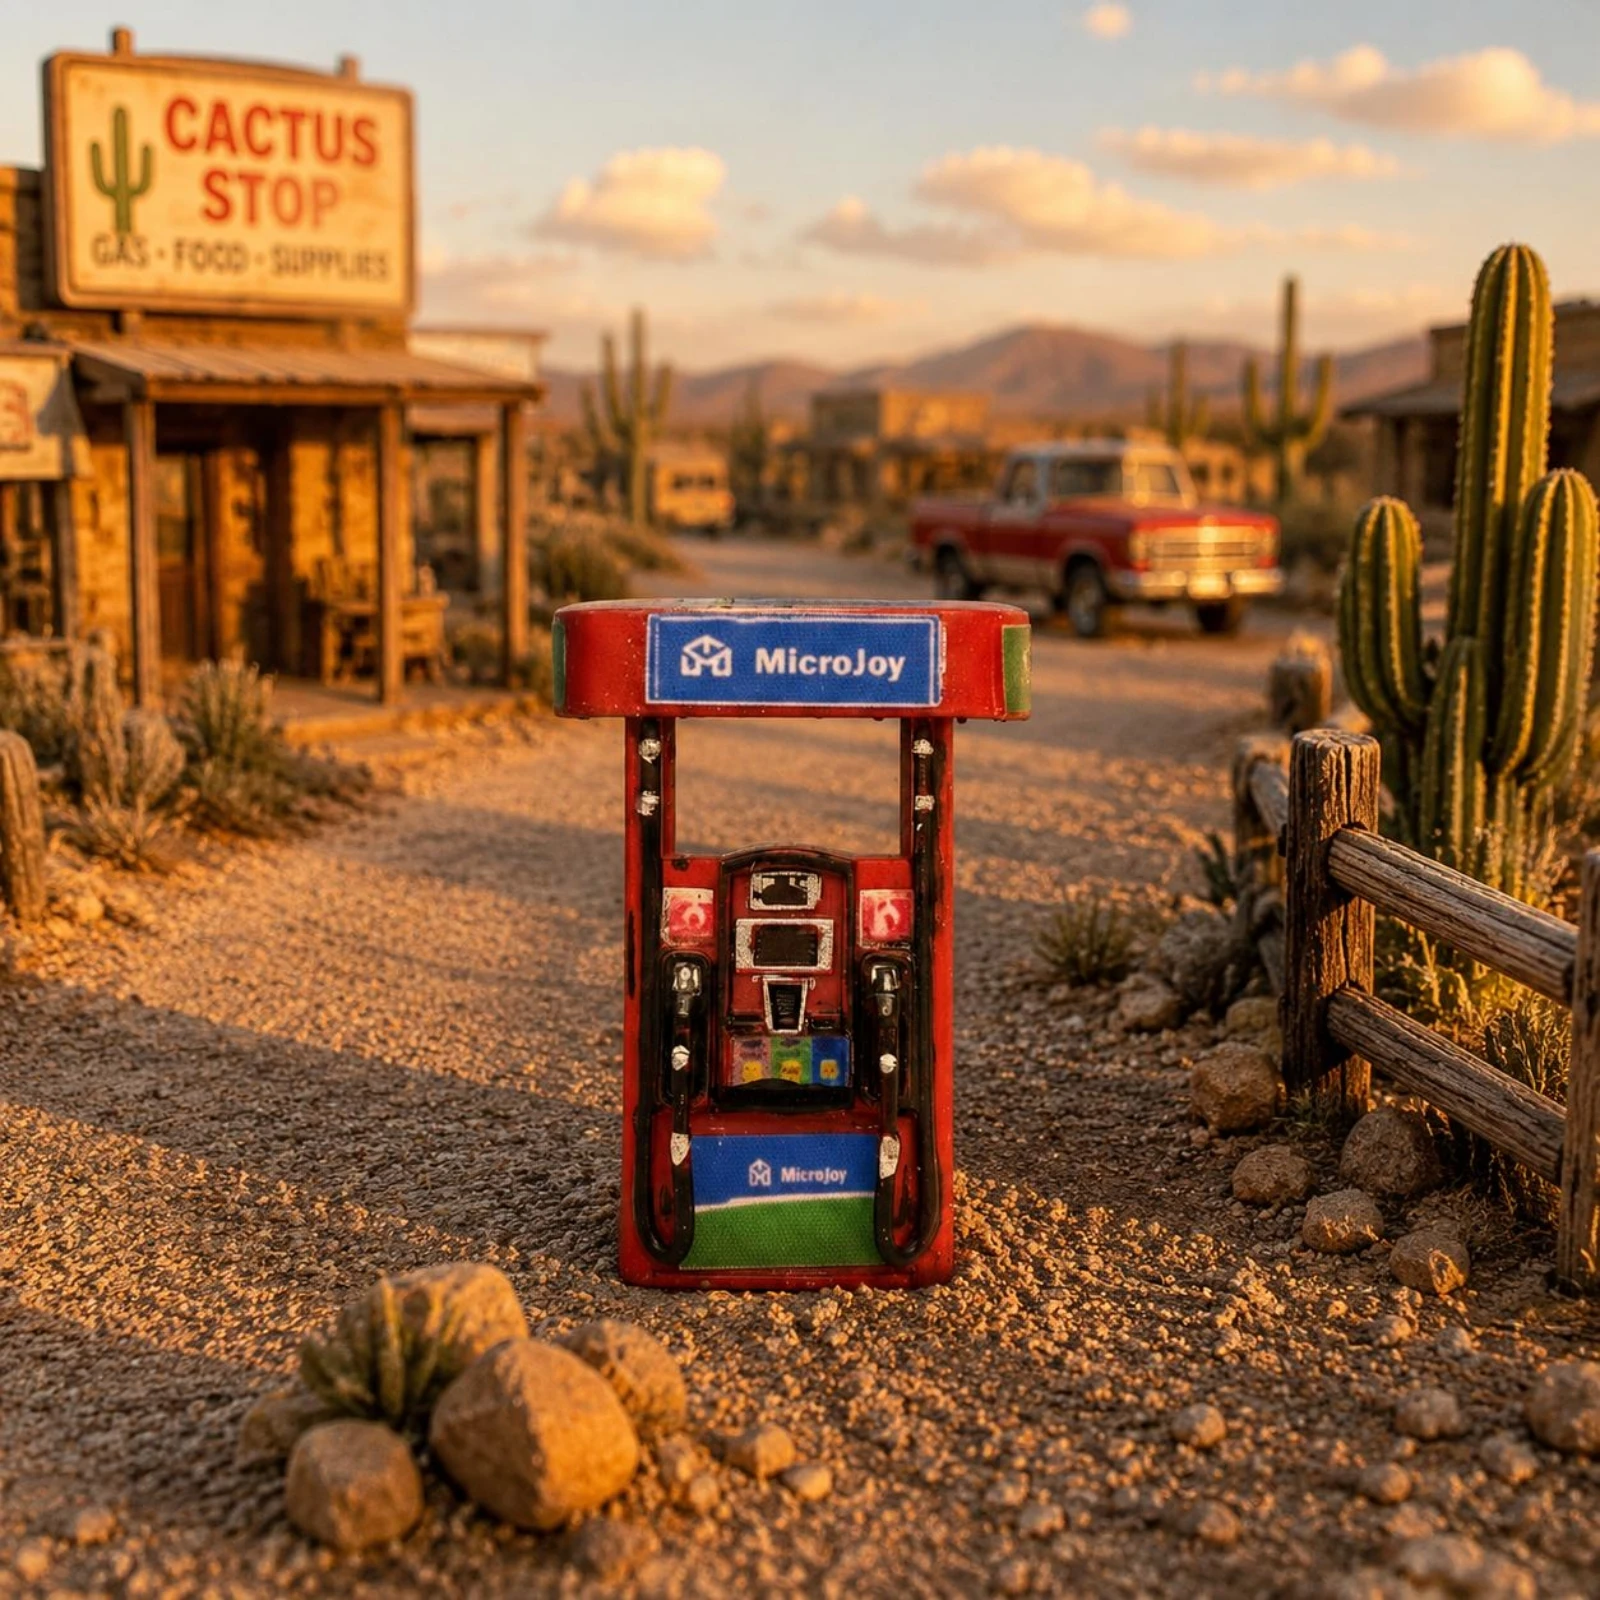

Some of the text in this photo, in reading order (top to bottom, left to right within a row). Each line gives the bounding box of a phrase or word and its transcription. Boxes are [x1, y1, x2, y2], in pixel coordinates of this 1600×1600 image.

[165, 96, 379, 168] CACTUS
[204, 170, 342, 229] STOP
[92, 235, 389, 282] GAS FOOD SUPPLIES
[755, 647, 906, 683] MicroJoy
[780, 1167, 847, 1185] MicroJoy
